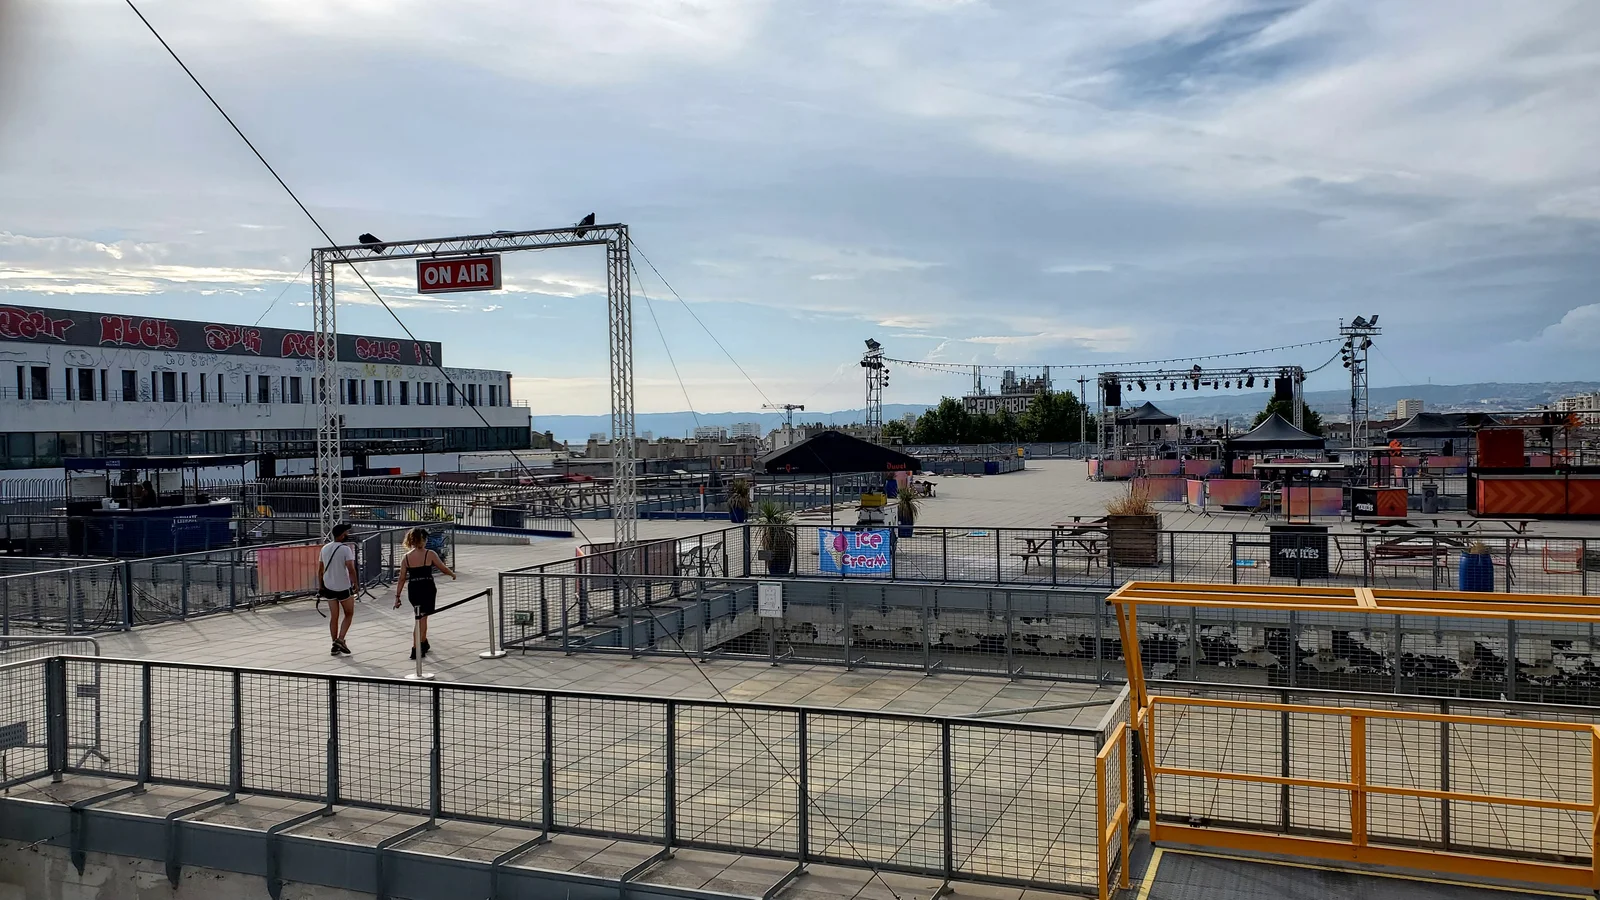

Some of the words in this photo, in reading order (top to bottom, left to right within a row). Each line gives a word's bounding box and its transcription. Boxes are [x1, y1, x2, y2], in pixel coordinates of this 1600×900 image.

[424, 265, 452, 285] ON
[457, 263, 489, 283] AIR
[886, 461, 907, 470] Duvel
